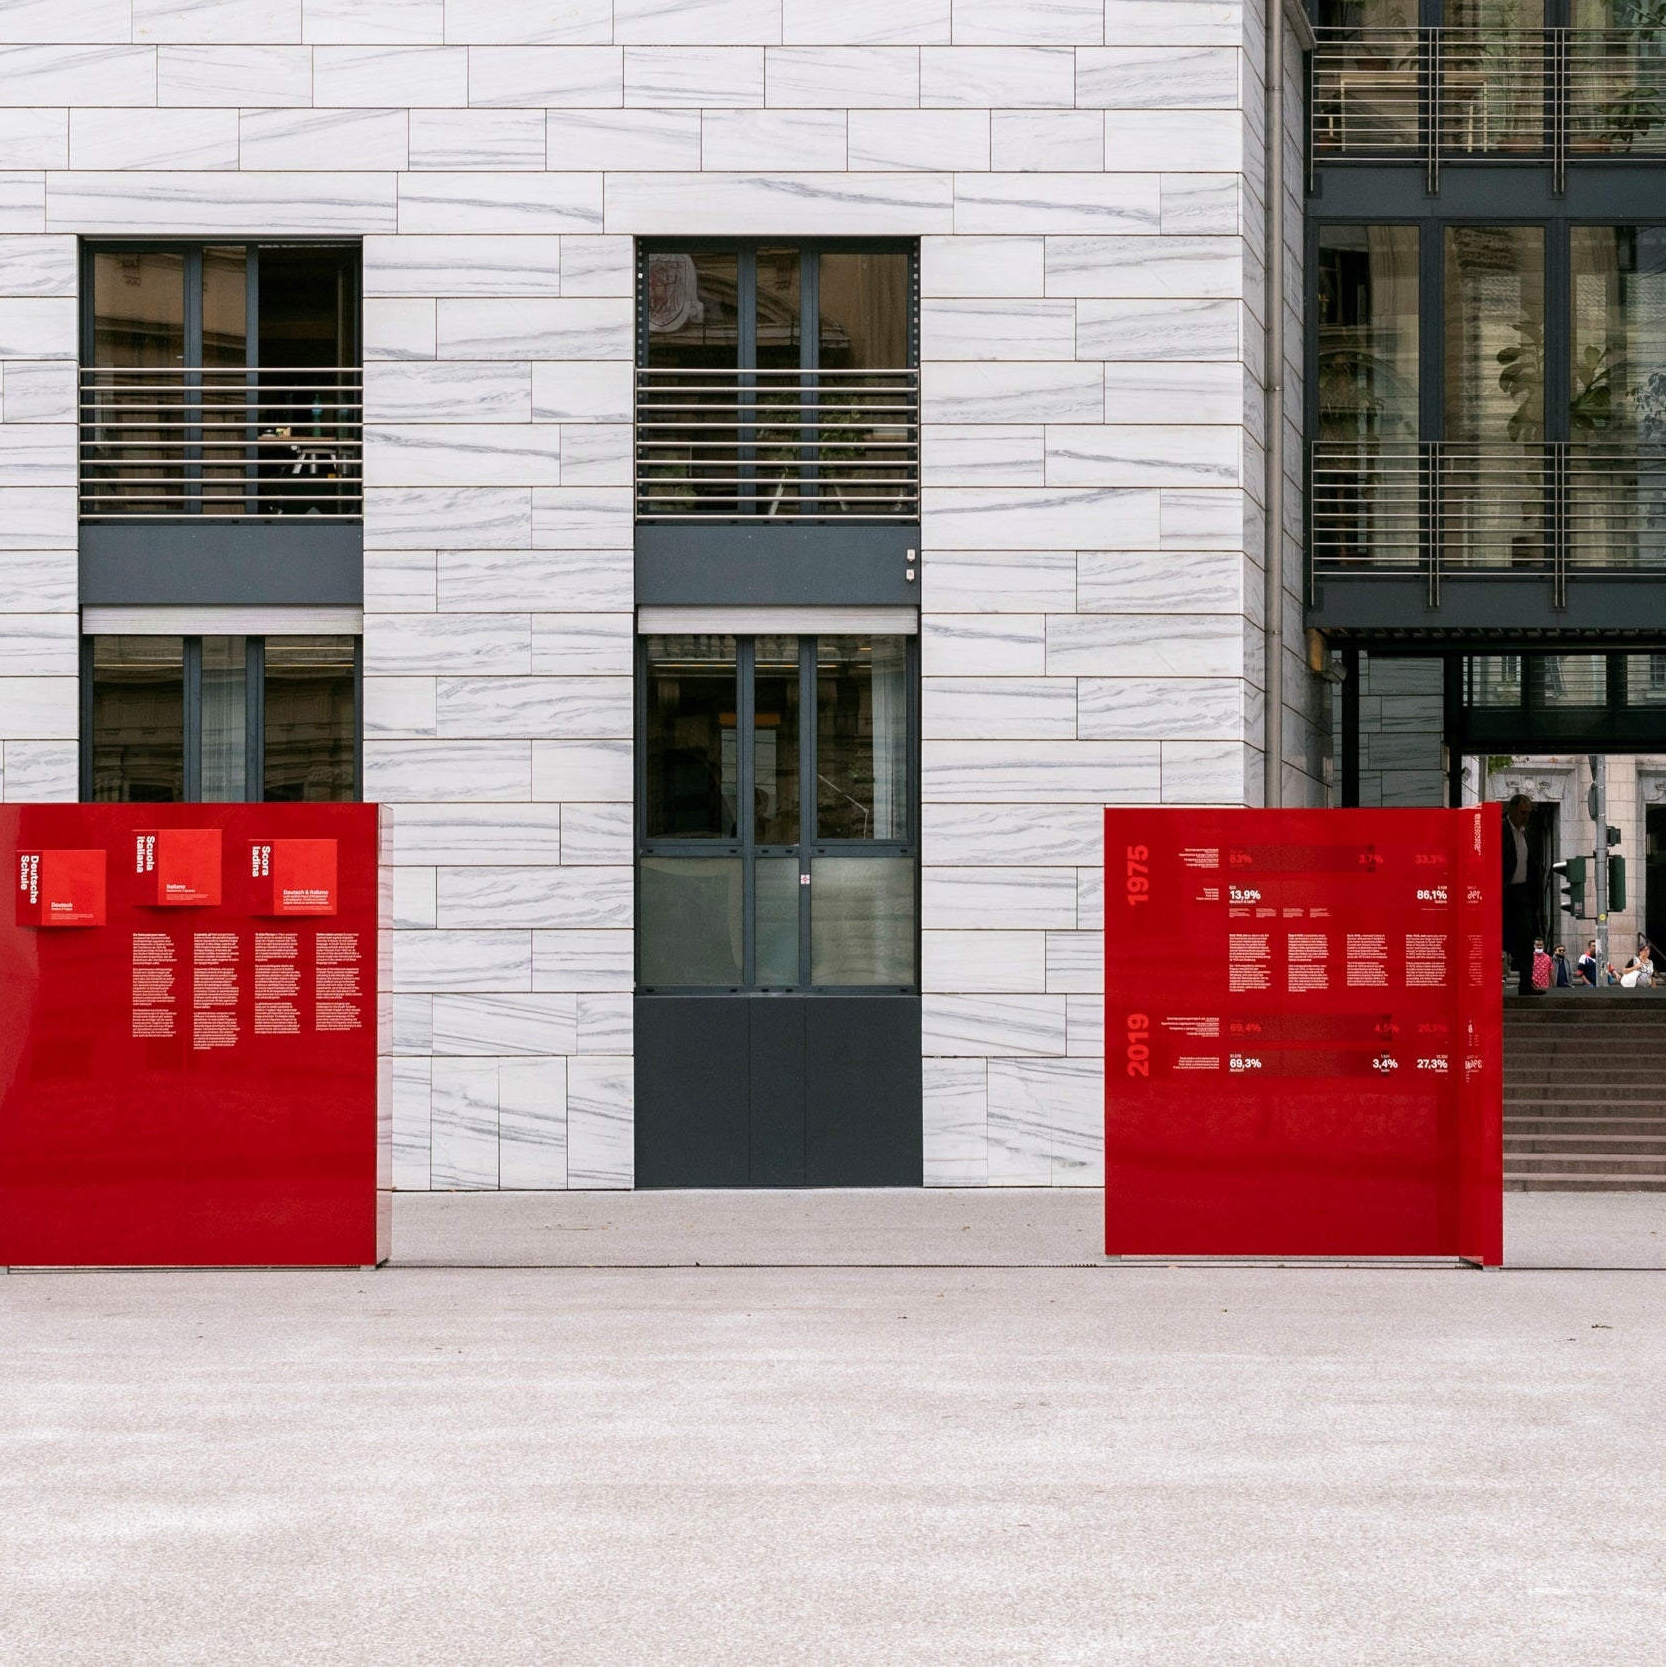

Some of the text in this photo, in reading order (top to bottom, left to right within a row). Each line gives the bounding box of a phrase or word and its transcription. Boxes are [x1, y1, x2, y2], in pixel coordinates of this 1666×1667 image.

[147, 836, 155, 871] Scuola
[1229, 854, 1252, 863] 63%
[1415, 854, 1447, 864] 33,3%
[253, 846, 261, 877] ladina
[262, 846, 271, 876] Scora
[21, 855, 29, 890] Schule
[1127, 846, 1149, 906] 1975
[30, 856, 39, 904] Deutsche
[1229, 890, 1261, 900] 13,9%
[1417, 890, 1447, 900] 86,1%
[1230, 1023, 1261, 1032] 69,4%
[1127, 1014, 1149, 1076] 2019
[1229, 1058, 1261, 1068] 69,3%
[1373, 1058, 1399, 1068] 3,4%
[1417, 1058, 1448, 1069] 27,3%
